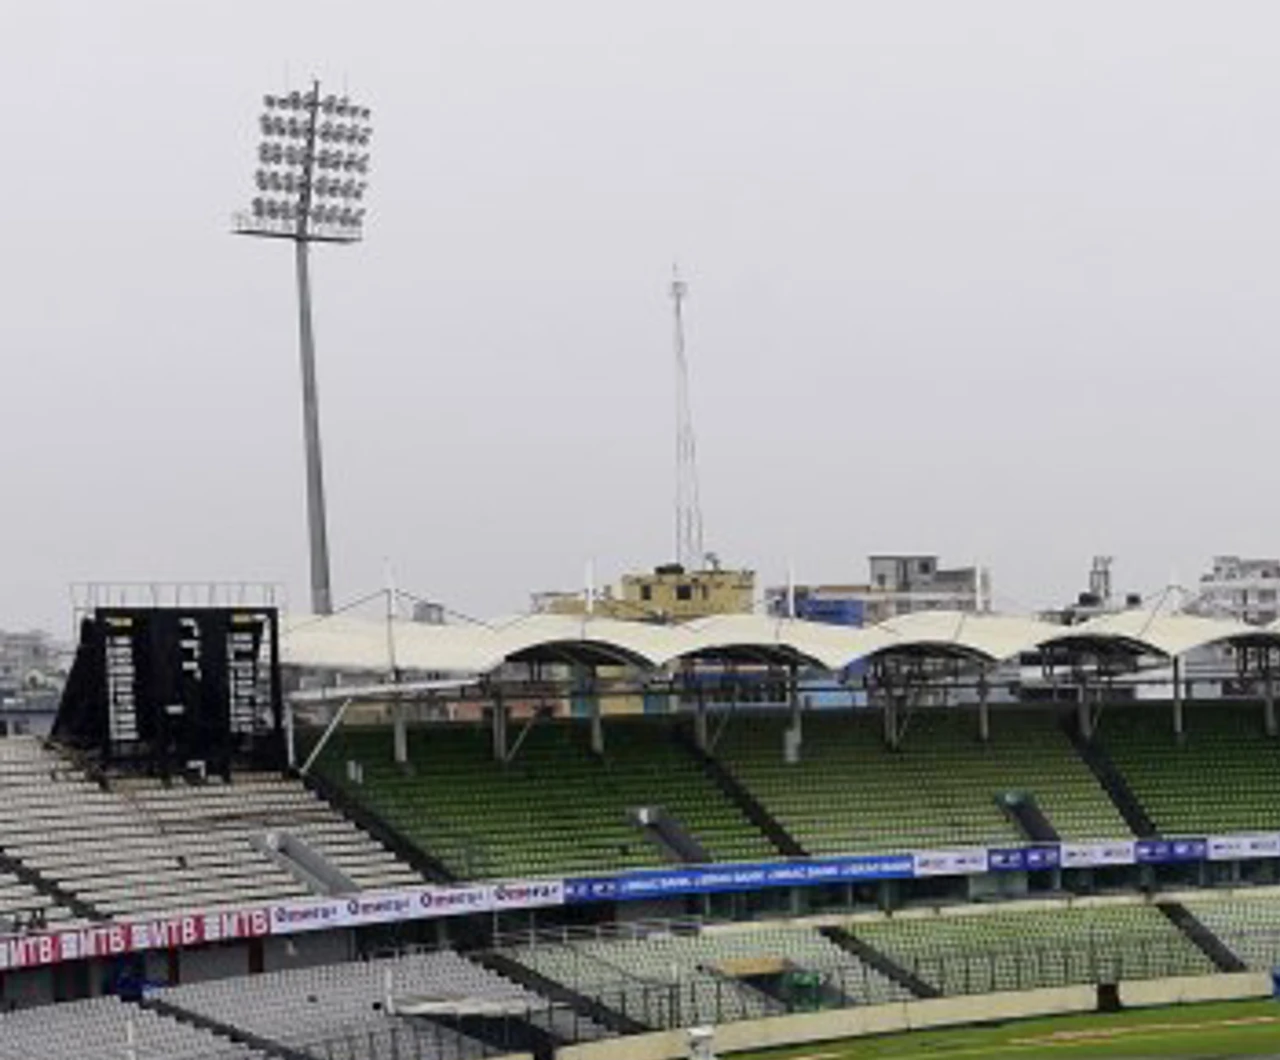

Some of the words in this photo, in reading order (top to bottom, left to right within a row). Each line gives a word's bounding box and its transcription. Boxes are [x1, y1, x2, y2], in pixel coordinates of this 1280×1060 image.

[151, 916, 197, 947] MTB
[222, 908, 268, 938] MTB
[10, 935, 50, 966] MTB
[79, 926, 125, 959] MTB
